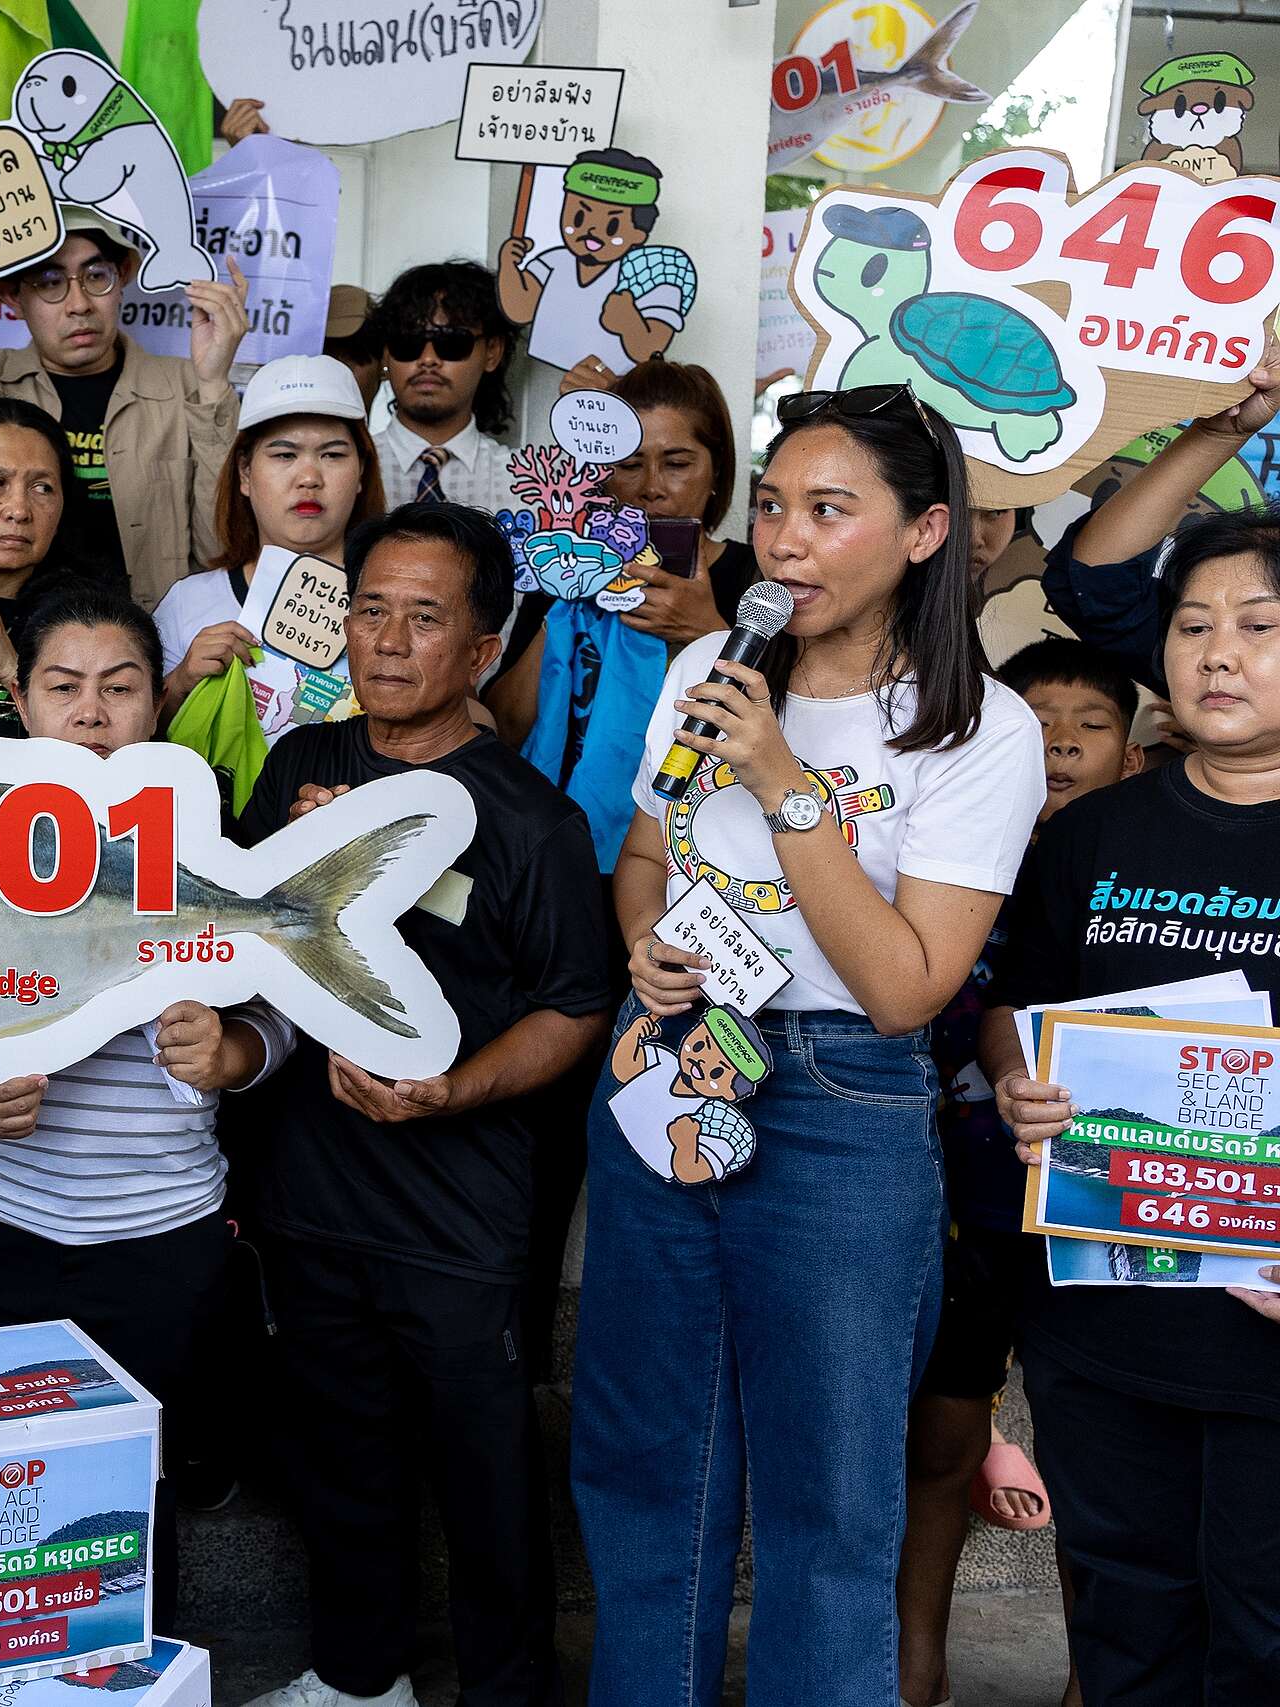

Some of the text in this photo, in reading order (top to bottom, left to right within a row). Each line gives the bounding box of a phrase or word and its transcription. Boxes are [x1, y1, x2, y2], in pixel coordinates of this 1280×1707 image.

[492, 78, 592, 105] อย่าลืมฟัง
[478, 116, 596, 144] เจ้าของบ้าน
[952, 167, 1278, 304] 646
[1078, 312, 1251, 369] องค์กร
[576, 398, 606, 412] หลบ
[568, 416, 618, 435] บ้านเฮา
[283, 593, 343, 636] คือบ้าน
[275, 619, 332, 659] ของเรา
[1089, 871, 1280, 921] สิ่งแวดล้อม
[136, 923, 235, 964] รายชื่อ
[699, 905, 765, 978] อย่าลืมฟัง
[674, 921, 749, 1006] เจ้าของบ้าน
[716, 1018, 756, 1065] GREENPEACE
[1179, 1045, 1274, 1075] STOP
[1177, 1072, 1272, 1095] SEC ACT.
[1181, 1090, 1264, 1112] & LAND
[1177, 1107, 1264, 1130] BRIDGE
[1070, 1119, 1260, 1157] หยุดแลนด์บริดจ์
[1127, 1159, 1257, 1196] 183,501
[1137, 1199, 1277, 1231] 646 องค์กร
[14, 1374, 71, 1391] รายชื่อ
[0, 1395, 65, 1412] องค์กร
[4, 1486, 46, 1509] ACT.
[44, 1534, 135, 1573] หยุดSEC
[44, 1583, 95, 1607] รายชื่อ
[7, 1629, 61, 1651] องค์กร
